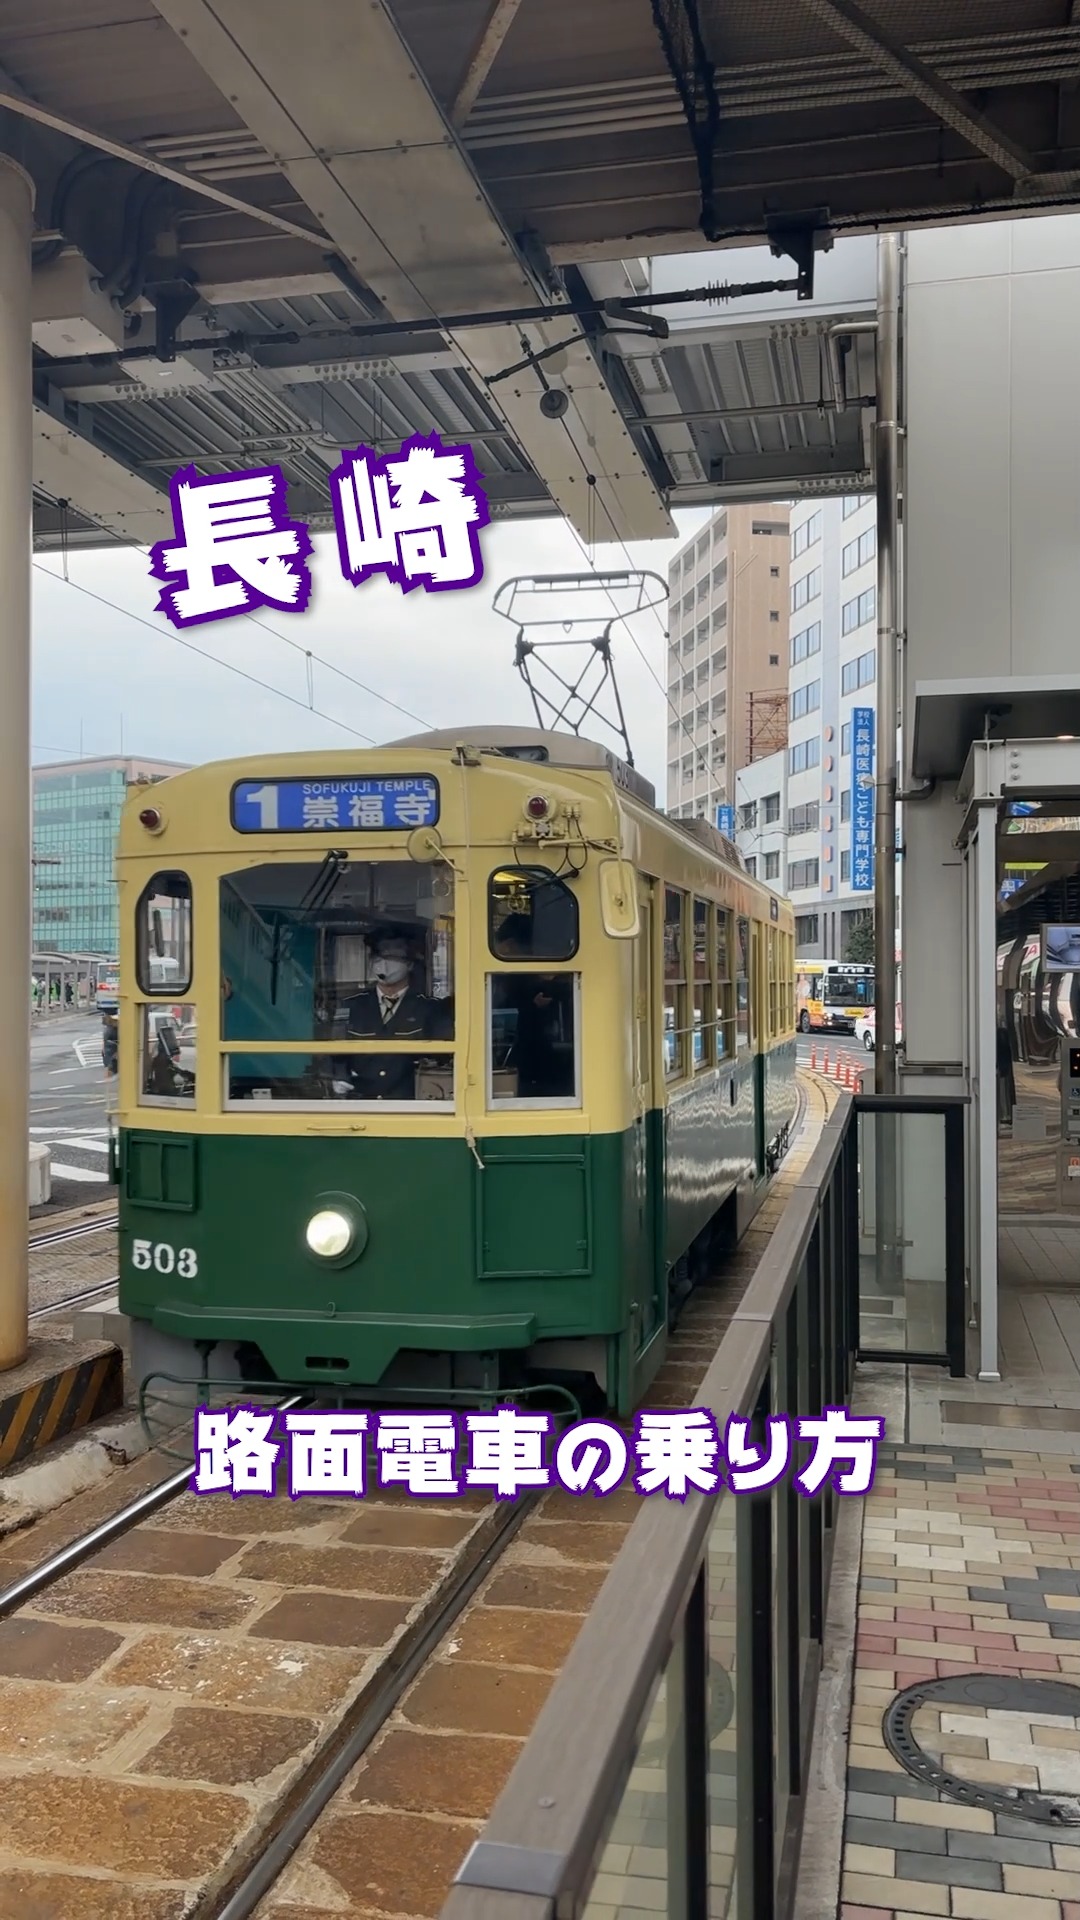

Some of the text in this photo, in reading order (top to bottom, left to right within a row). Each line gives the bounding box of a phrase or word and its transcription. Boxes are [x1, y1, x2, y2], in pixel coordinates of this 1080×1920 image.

[303, 779, 431, 795] SOFUKUJI TEMPLE
[246, 785, 279, 829] 1
[303, 793, 431, 828] 崇福寺
[132, 1239, 198, 1278] 503
